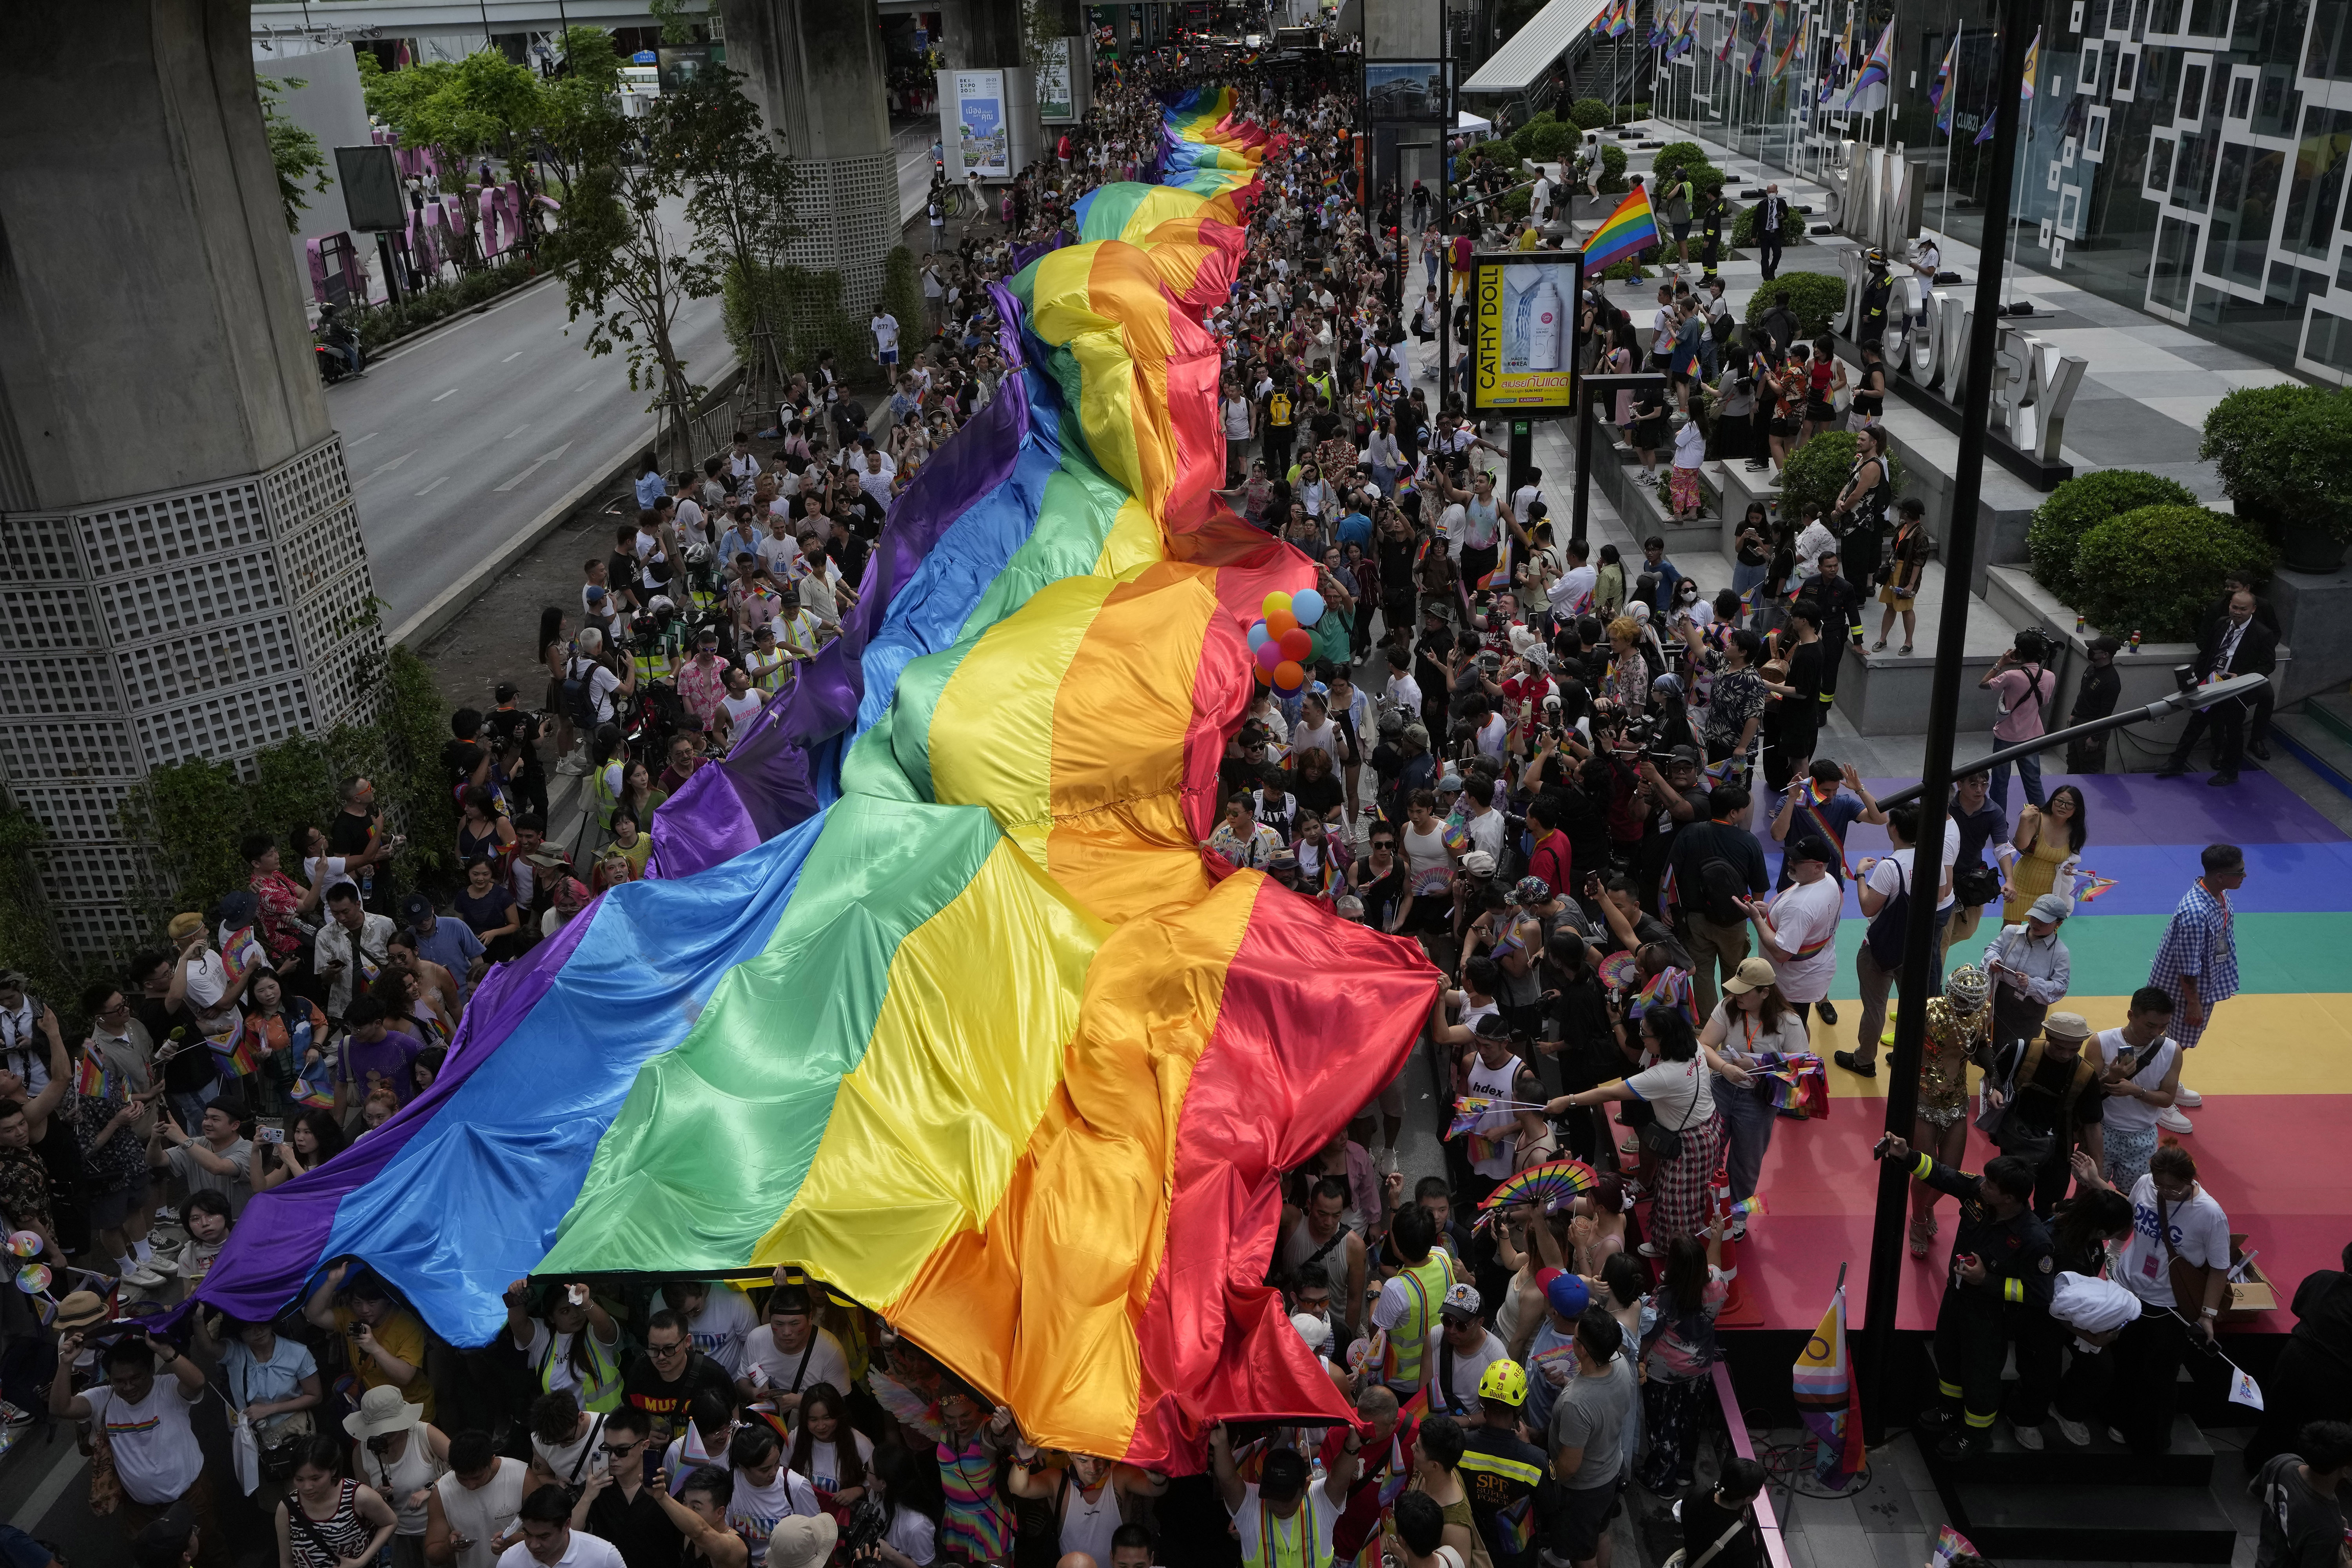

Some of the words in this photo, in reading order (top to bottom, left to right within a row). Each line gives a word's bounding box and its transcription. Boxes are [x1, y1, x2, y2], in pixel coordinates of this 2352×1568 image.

[1956, 112, 1979, 132] CLUB21
[1482, 268, 1497, 316] DOLL
[1480, 321, 1496, 389] CATHY
[1259, 810, 1288, 822] NAVY
[1473, 1082, 1504, 1098] hdex
[1489, 1389, 1506, 1400] ป้องกัน
[645, 1397, 691, 1413] MUSC
[1477, 1475, 1509, 1493] SPF
[1477, 1488, 1509, 1500] SUPER
[1477, 1495, 1509, 1505] FORCE
